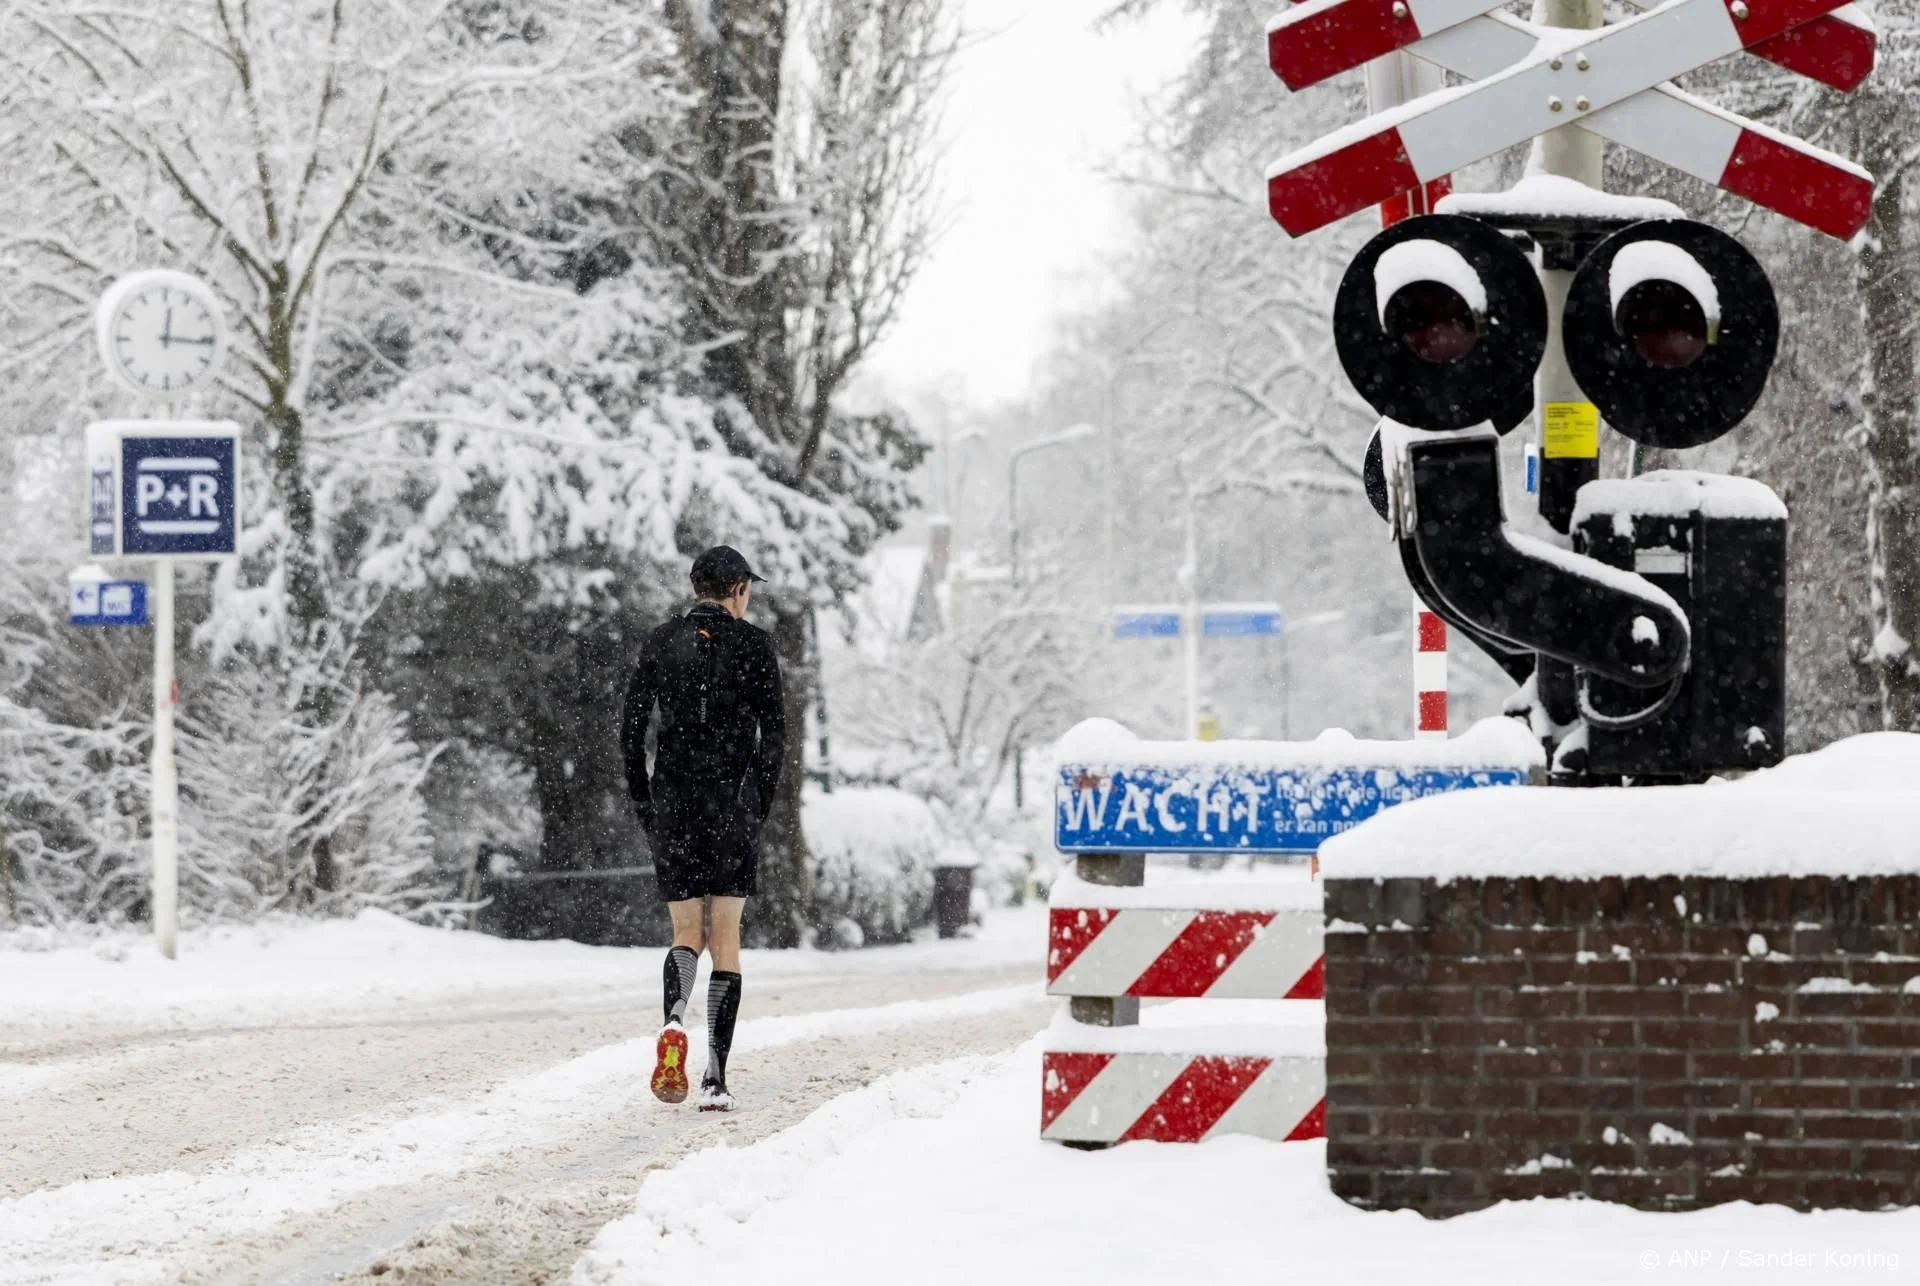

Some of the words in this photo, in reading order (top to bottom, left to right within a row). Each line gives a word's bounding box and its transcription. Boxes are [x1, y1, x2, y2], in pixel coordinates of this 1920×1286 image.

[136, 473, 220, 517] P+R
[1059, 780, 1269, 833] WACHT
[1274, 820, 1294, 833] er
[1332, 819, 1360, 833] no
